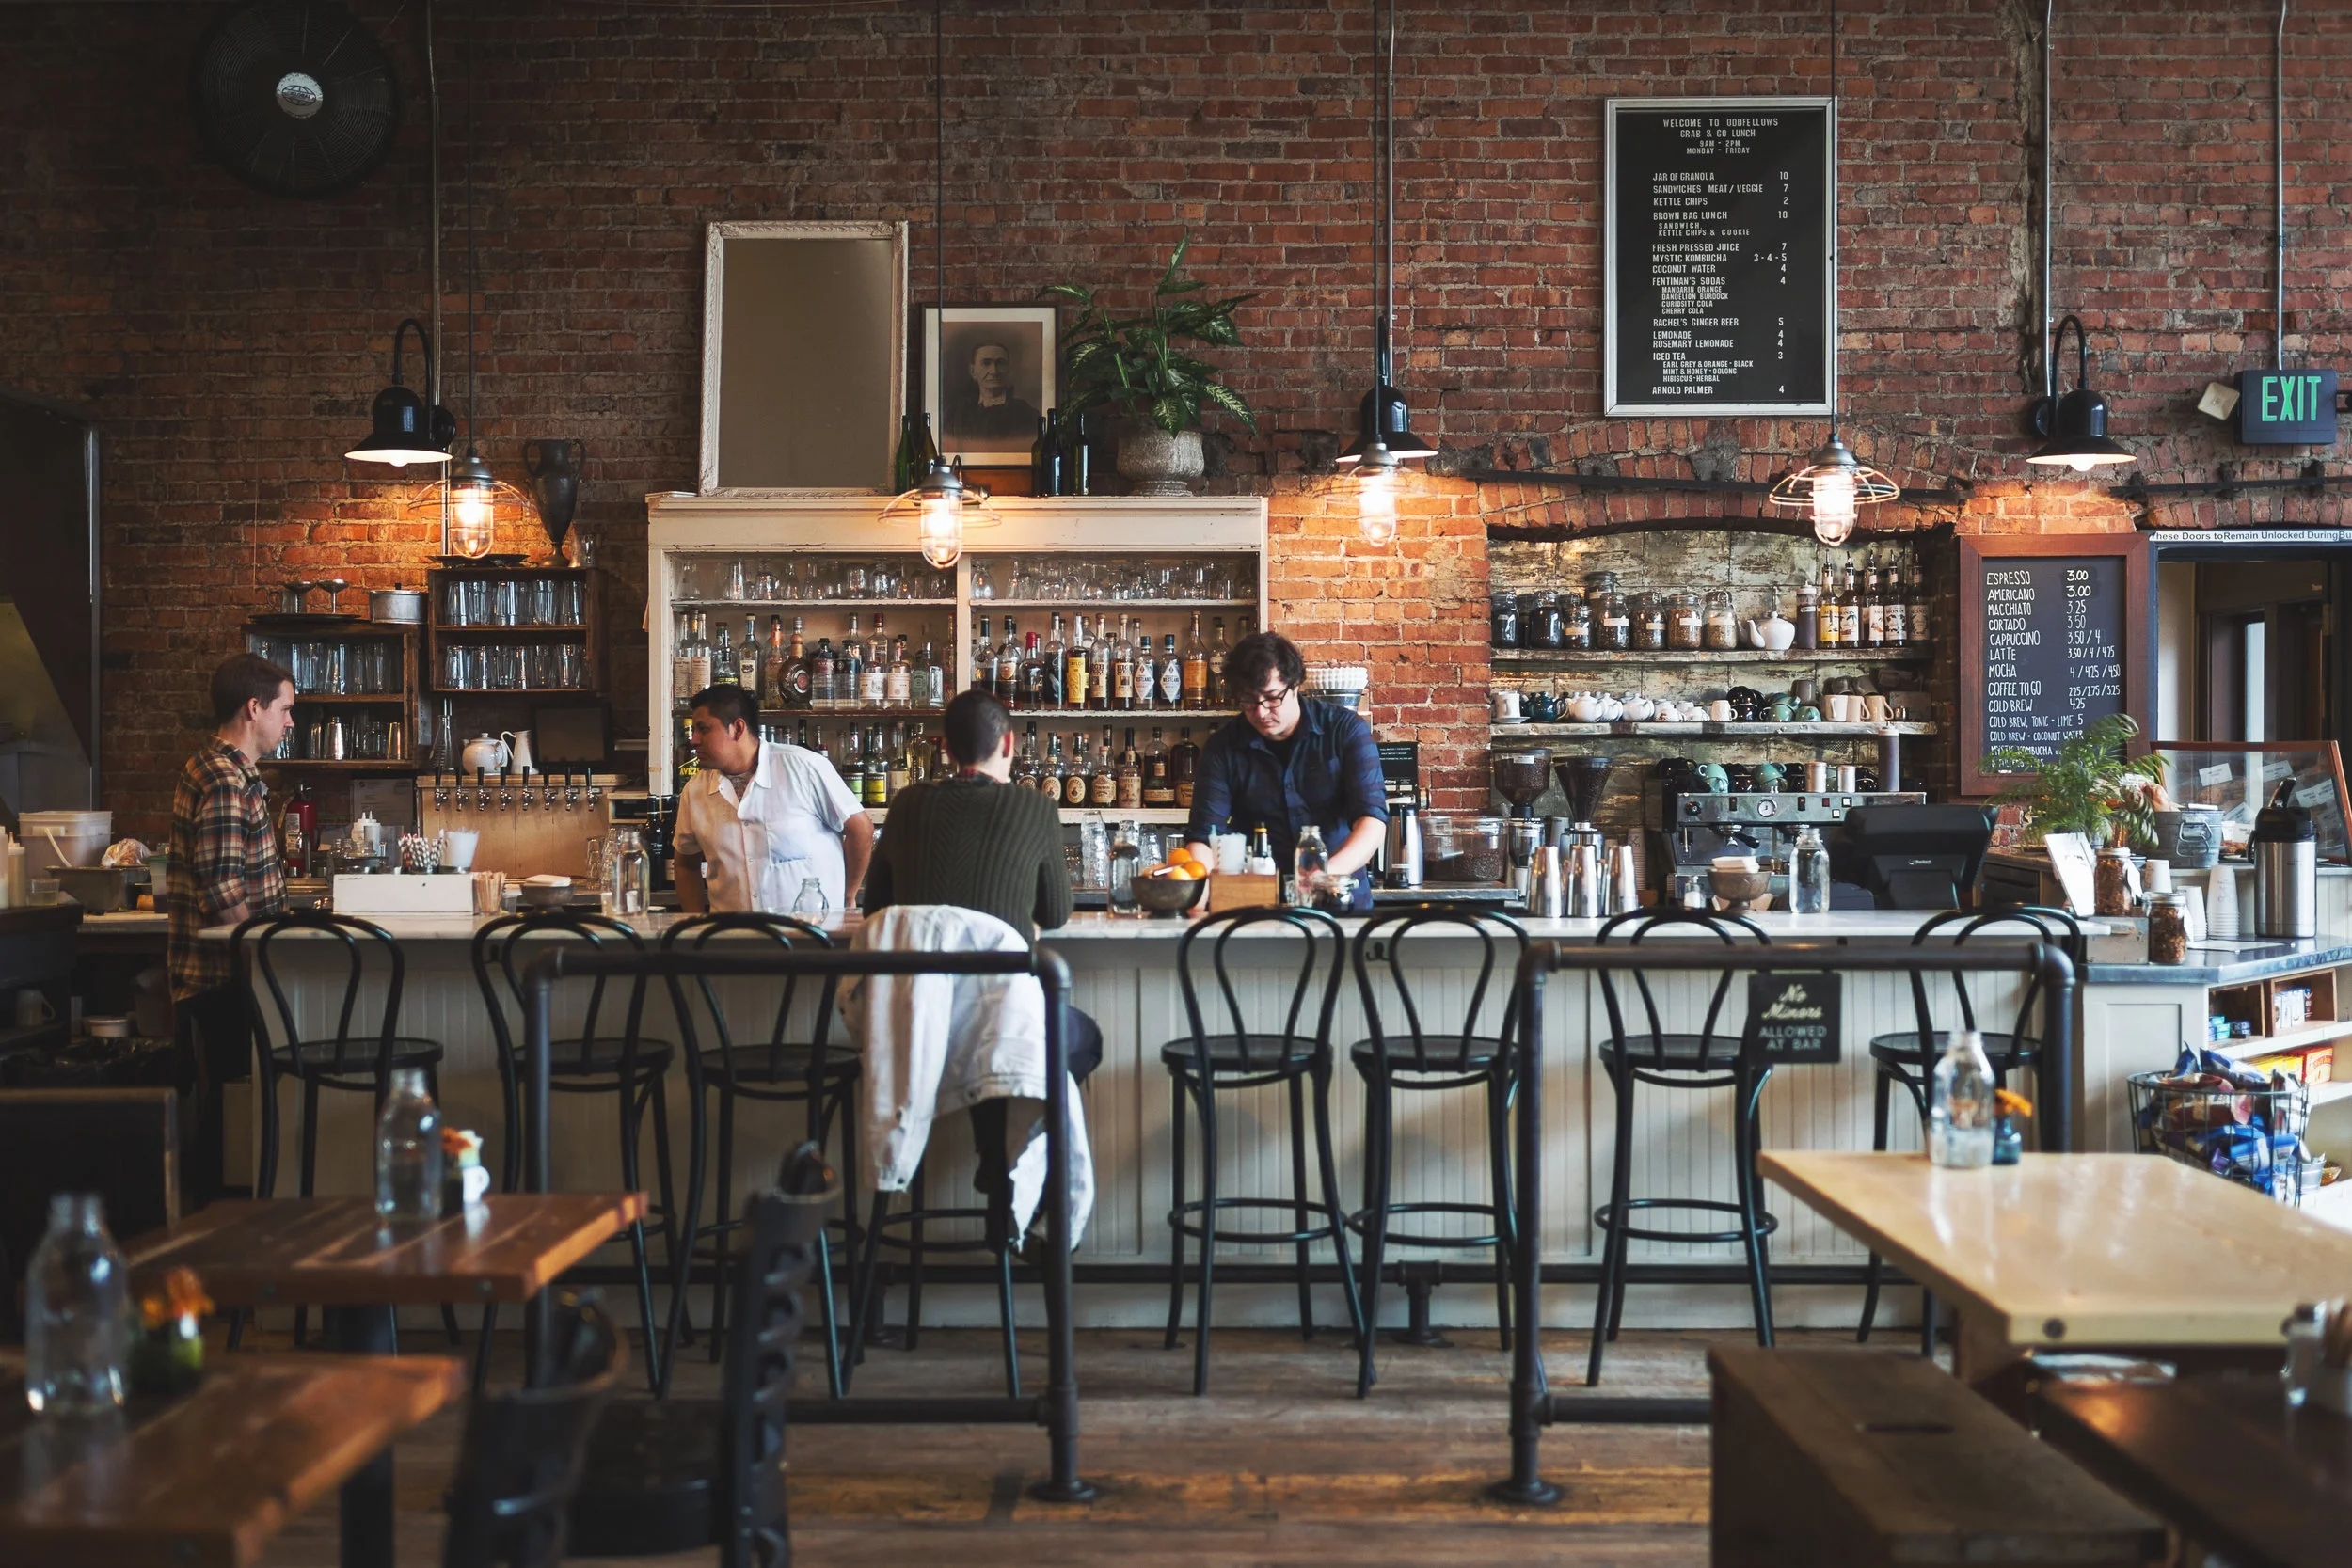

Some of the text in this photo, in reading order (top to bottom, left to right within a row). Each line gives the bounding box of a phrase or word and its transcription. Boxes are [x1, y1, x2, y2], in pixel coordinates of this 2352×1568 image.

[1663, 118, 1779, 128] WELCOME TO ODDFELLOWS
[1680, 128, 1756, 138] GRAB & GO LUNCH
[1652, 171, 1788, 182] JAR OF GRANOLA 10
[1653, 184, 1702, 194] SANDWICHES
[1783, 183, 1788, 192] 7
[1653, 196, 1788, 206] KETTLE CHIPS 2
[1653, 210, 1788, 220] BROWN BAG LUNCH 10
[1652, 242, 1787, 252] FRESH PRESSED JUICE 7
[1652, 254, 1683, 262] MYSTIC
[1685, 253, 1727, 262] KOMBUCHA
[1754, 253, 1759, 261] 3
[1767, 253, 1772, 261] 4
[1781, 252, 1787, 261] 5
[1652, 263, 1787, 274] COCONUT WATER 4
[1652, 276, 1786, 286] FENTIMAN'S SODAS 4
[1653, 317, 1784, 327] RACHEL'S GINGER BEER 5
[1653, 329, 1784, 340] LEMONADE 4
[1652, 339, 1784, 348] ROSEMARY LEMONADE 4
[1653, 351, 1784, 361] ICED TEA 3
[1652, 385, 1785, 395] ARNOLD PALMER 4
[2262, 376, 2322, 421] EXIT
[2182, 531, 2211, 540] Doors
[2214, 531, 2223, 540] to
[2223, 531, 2259, 540] Remain
[2261, 531, 2305, 539] Unlocked
[2307, 531, 2339, 542] During
[1986, 569, 2089, 585] ESPRESSO 3.00
[1987, 585, 2091, 601] AMERICANO 3.00
[1988, 599, 2087, 616] MACCHIATO 3.25
[1988, 614, 2087, 631] CORTADO 3.50
[1989, 630, 2041, 646] CAPPUCCINO
[2067, 630, 2085, 644] 3.50
[2095, 629, 2101, 644] 4
[1990, 646, 2016, 661] LATTE
[2067, 647, 2082, 659] 3.50
[2089, 647, 2094, 658] 4
[1988, 663, 2017, 678] MOCHA
[2070, 666, 2075, 678] 4
[1988, 681, 2017, 696] COFFEE
[2019, 681, 2029, 696] TO
[2030, 680, 2042, 696] GO
[1988, 699, 2009, 713] COLD
[2010, 698, 2033, 712] BREW
[1989, 716, 2007, 728] COLD
[2032, 715, 2049, 728] TONIC
[2057, 714, 2074, 727] LIME
[2077, 713, 2084, 726] 5
[1989, 731, 2006, 741] COLD
[2009, 731, 2026, 741] BREW
[2033, 730, 2060, 741] COCONUT
[1779, 983, 1807, 1004] No
[1761, 1002, 1823, 1020] Minors
[1758, 1025, 1828, 1038] ALLOWED
[1766, 1038, 1821, 1050] AT BAR
